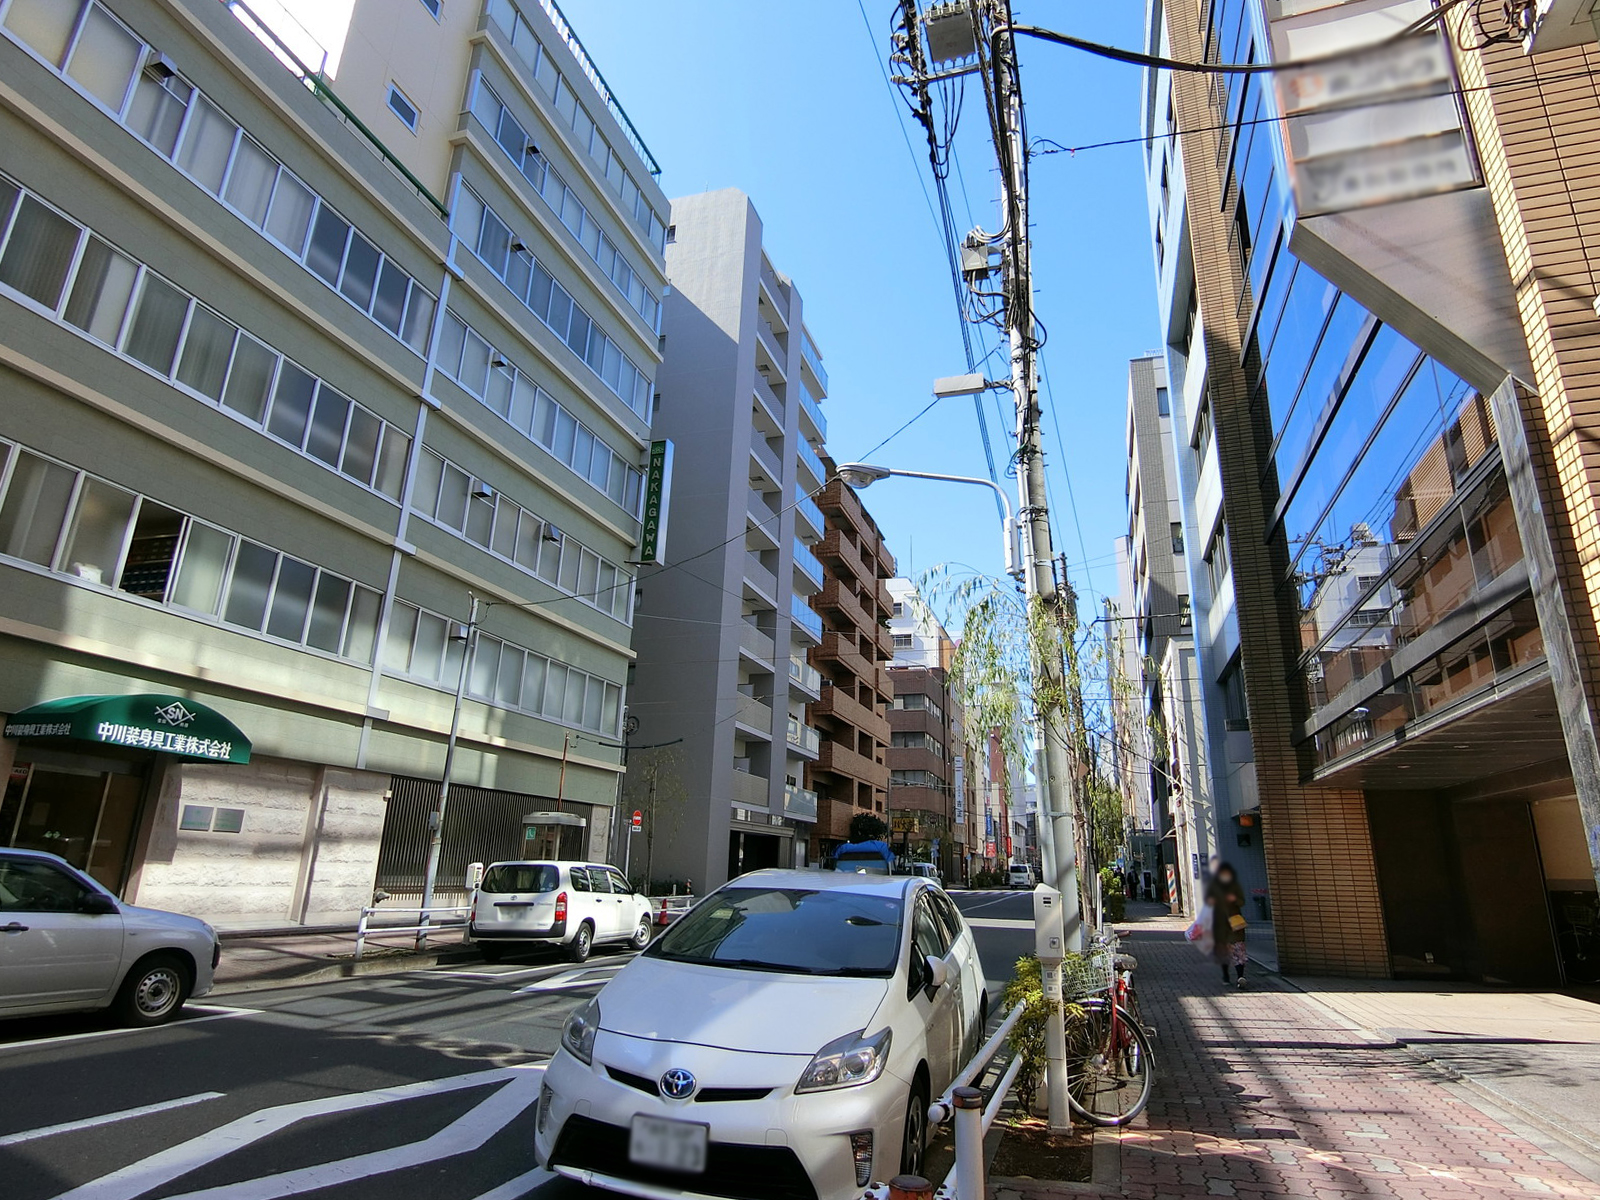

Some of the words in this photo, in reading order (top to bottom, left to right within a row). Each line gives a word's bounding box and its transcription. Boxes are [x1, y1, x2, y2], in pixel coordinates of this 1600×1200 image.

[644, 457, 661, 556] NAKAGAWA
[166, 706, 184, 720] SN
[98, 721, 232, 759] 中川装身具工業株式会社
